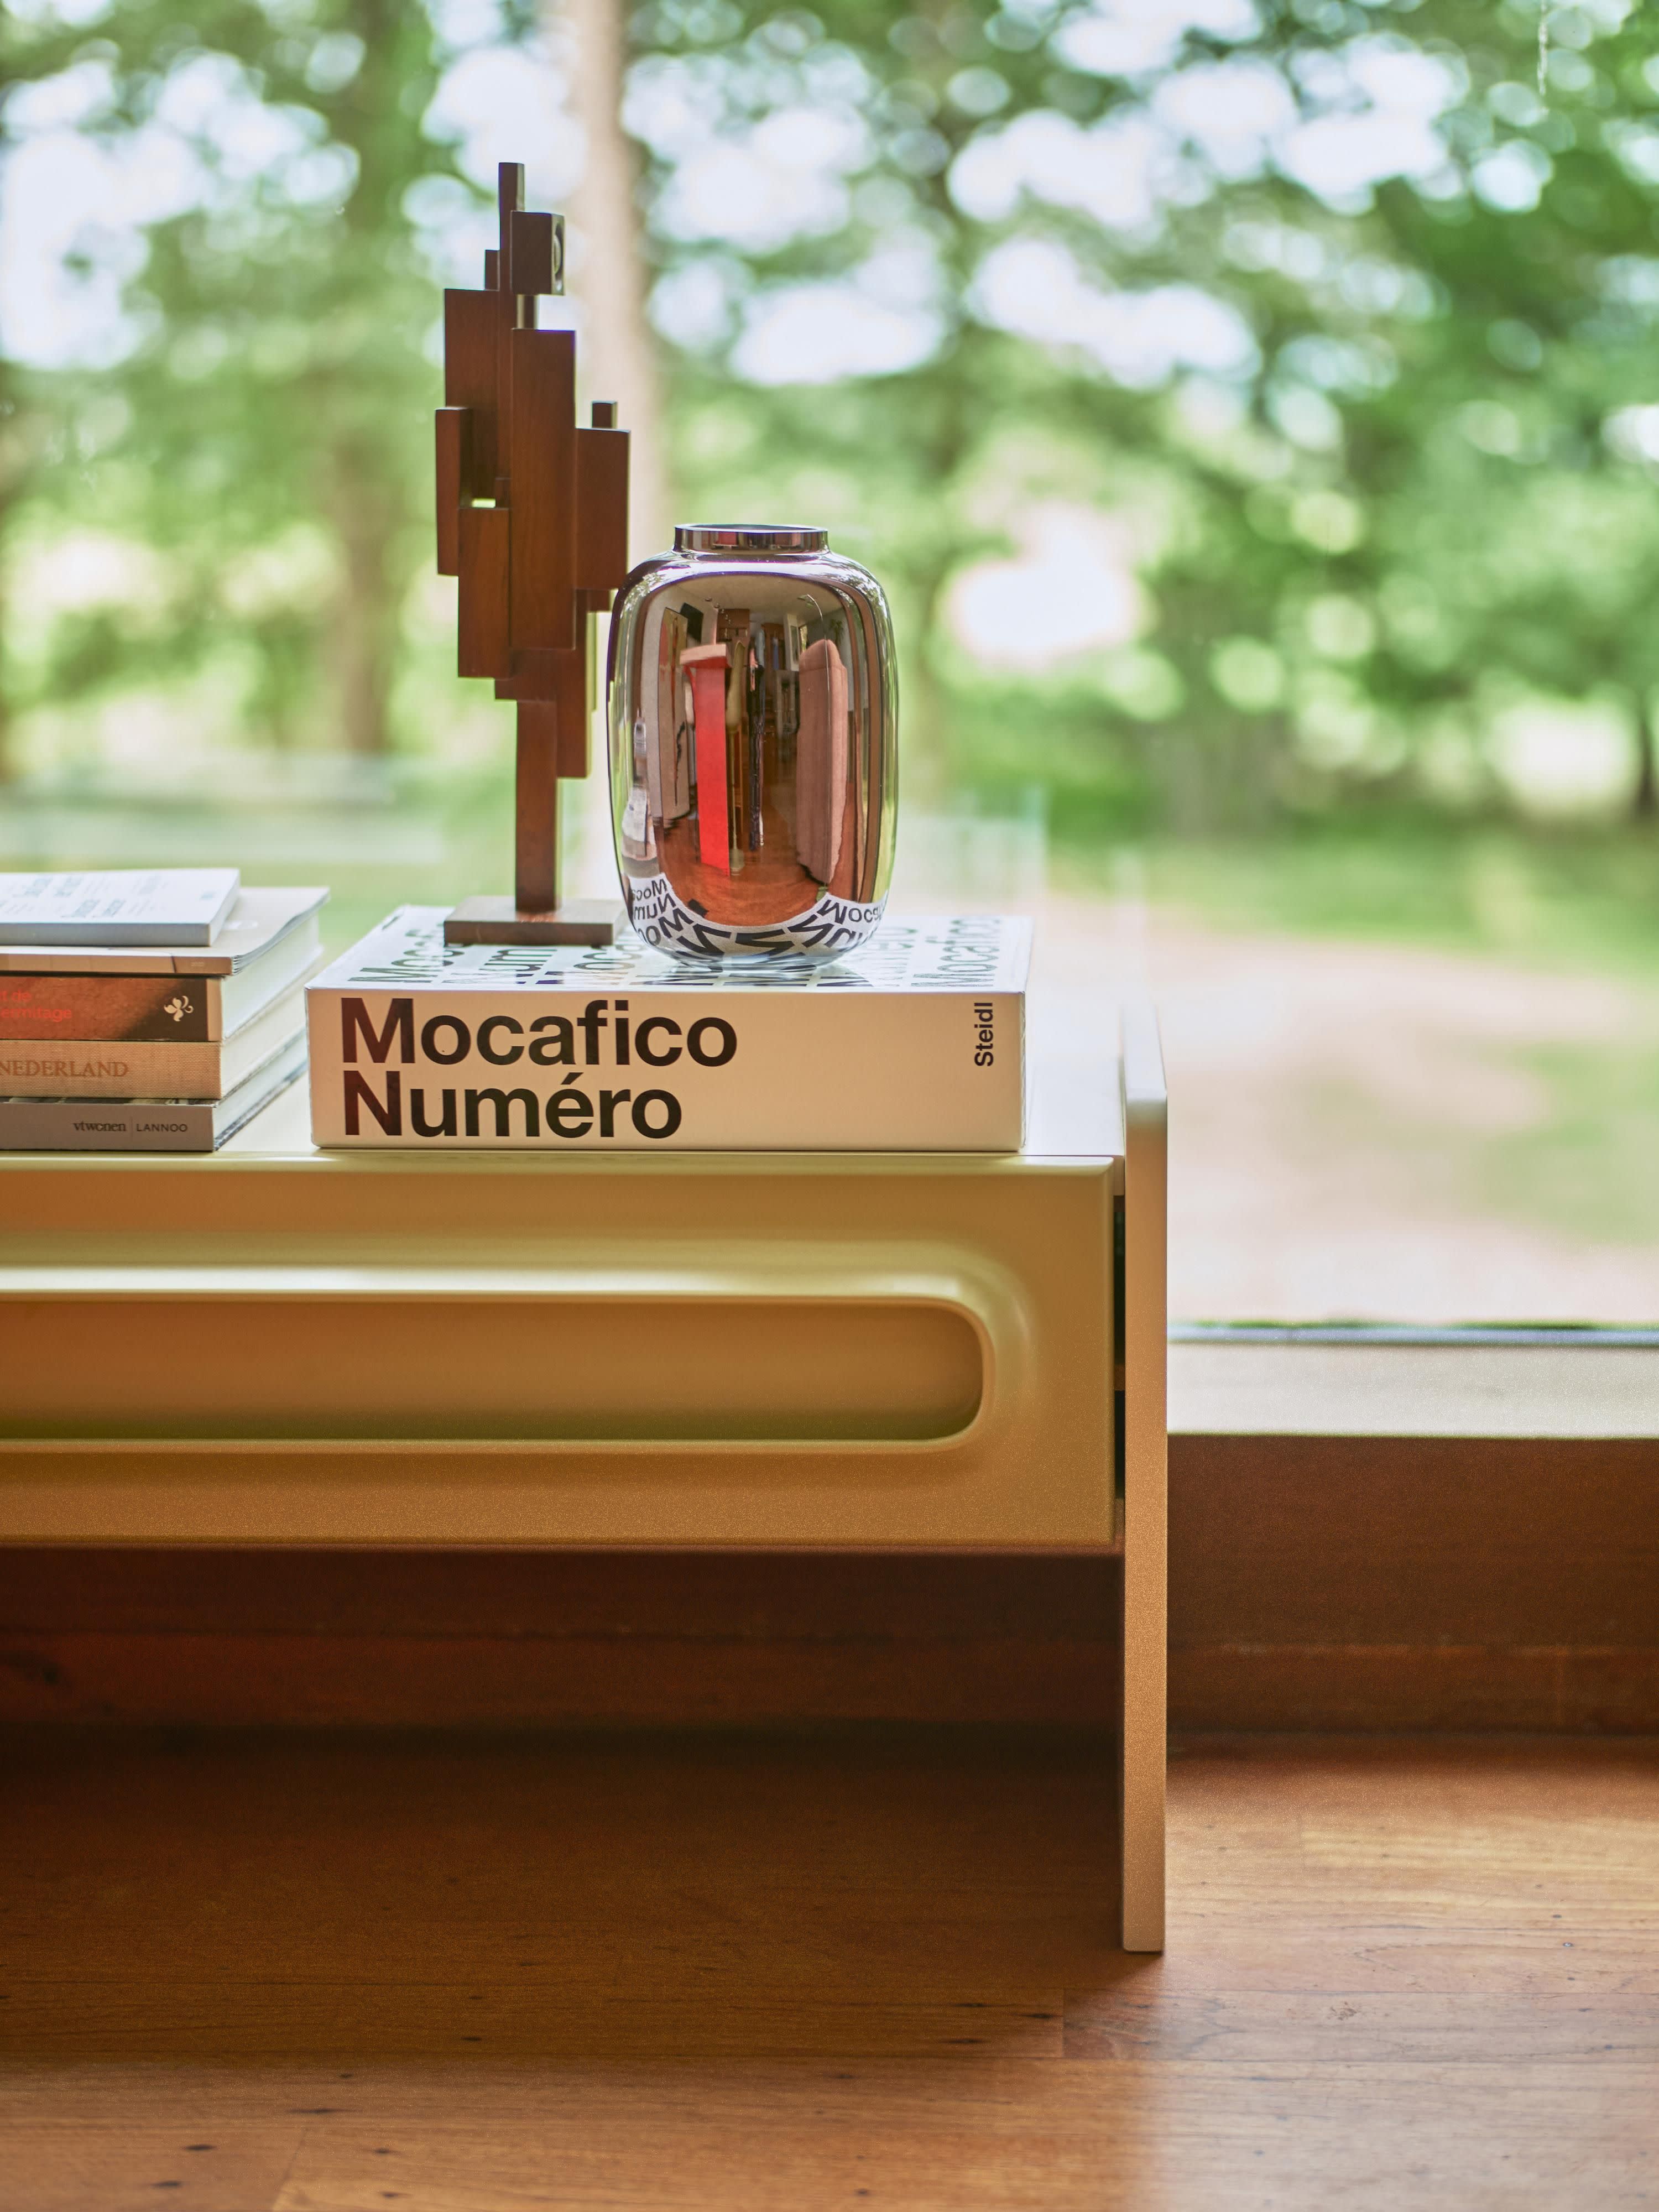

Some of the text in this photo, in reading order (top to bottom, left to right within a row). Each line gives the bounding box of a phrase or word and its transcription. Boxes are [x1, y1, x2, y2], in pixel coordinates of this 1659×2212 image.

[11, 988, 32, 1002] de
[341, 997, 738, 1067] Mocafico
[974, 1002, 994, 1067] Steidl
[0, 1060, 128, 1077] NEDERLAND
[343, 1071, 682, 1139] Numéro
[136, 1123, 188, 1132] LANNOO
